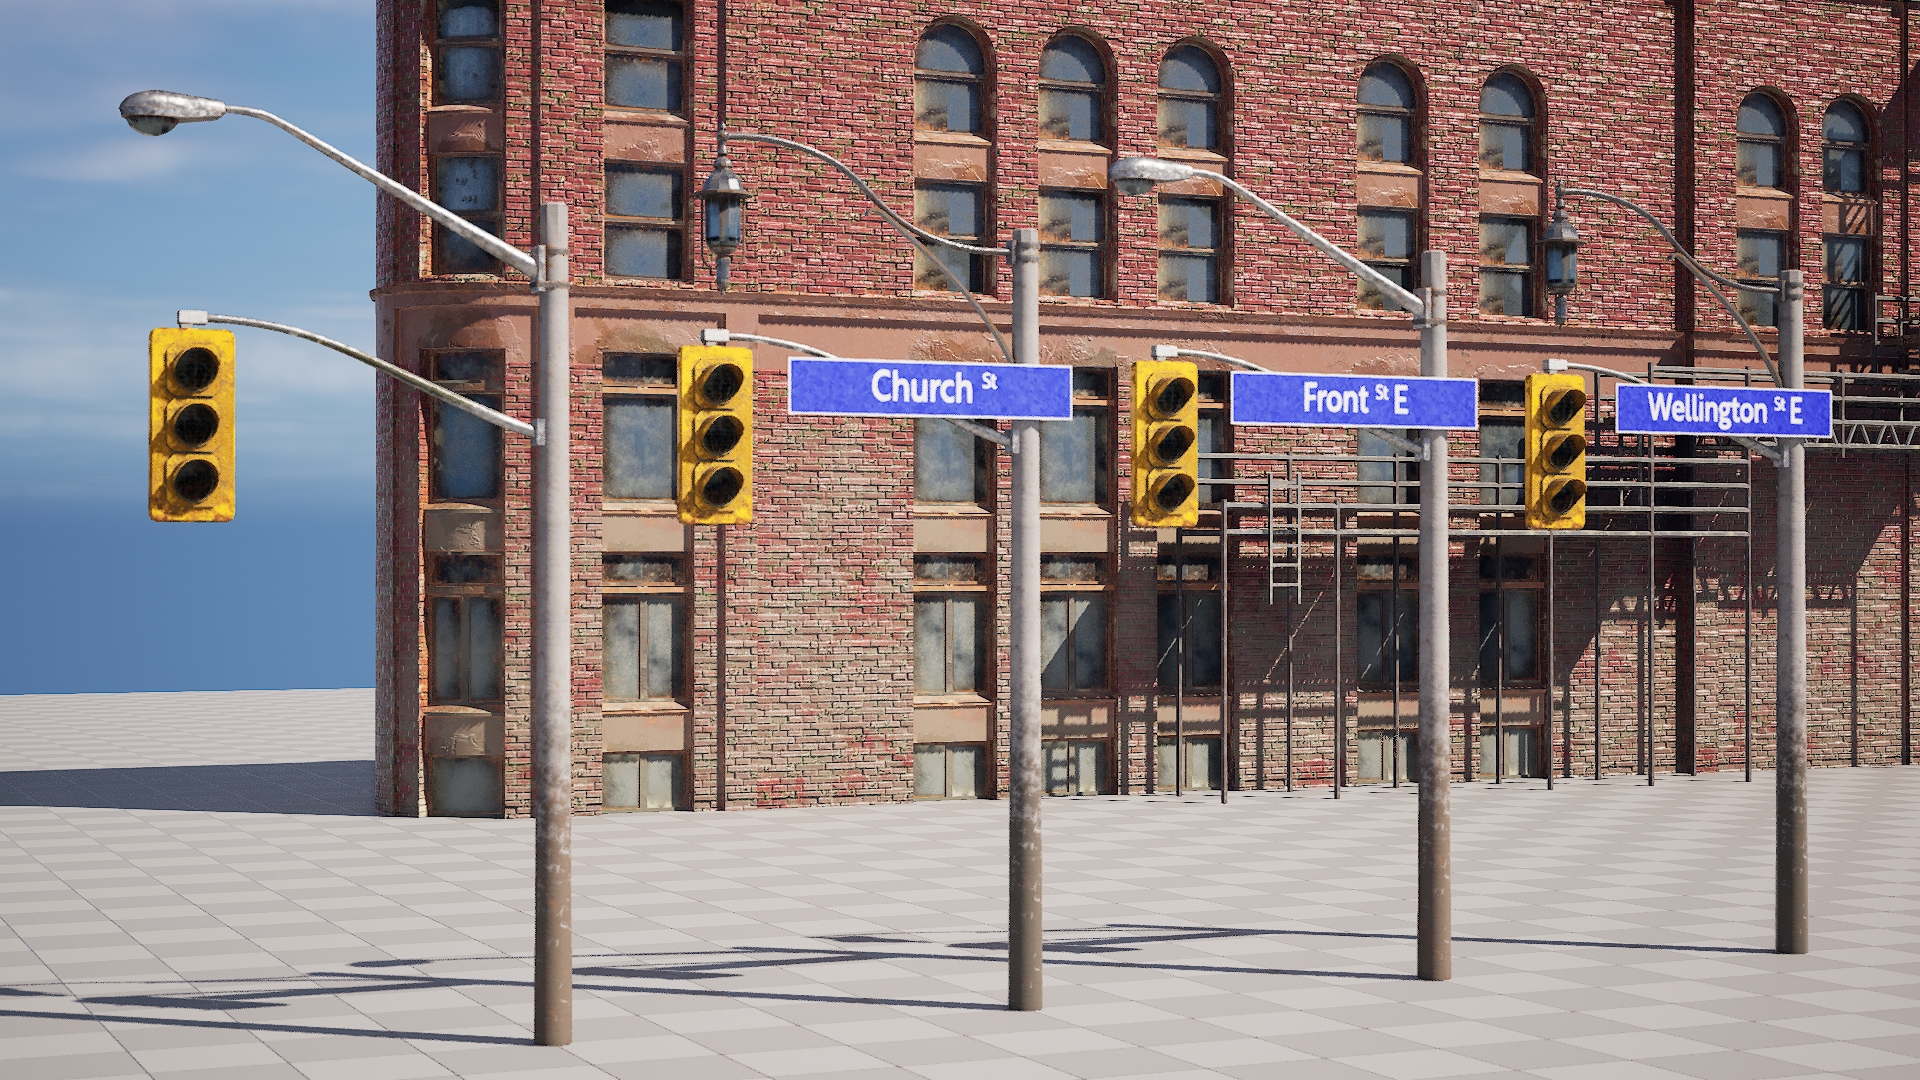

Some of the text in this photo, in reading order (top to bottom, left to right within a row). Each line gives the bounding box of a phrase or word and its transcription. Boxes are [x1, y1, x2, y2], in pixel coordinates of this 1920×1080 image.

[871, 368, 998, 404] Church St
[1303, 380, 1410, 415] Front St E
[1647, 391, 1804, 430] Wellington St E
